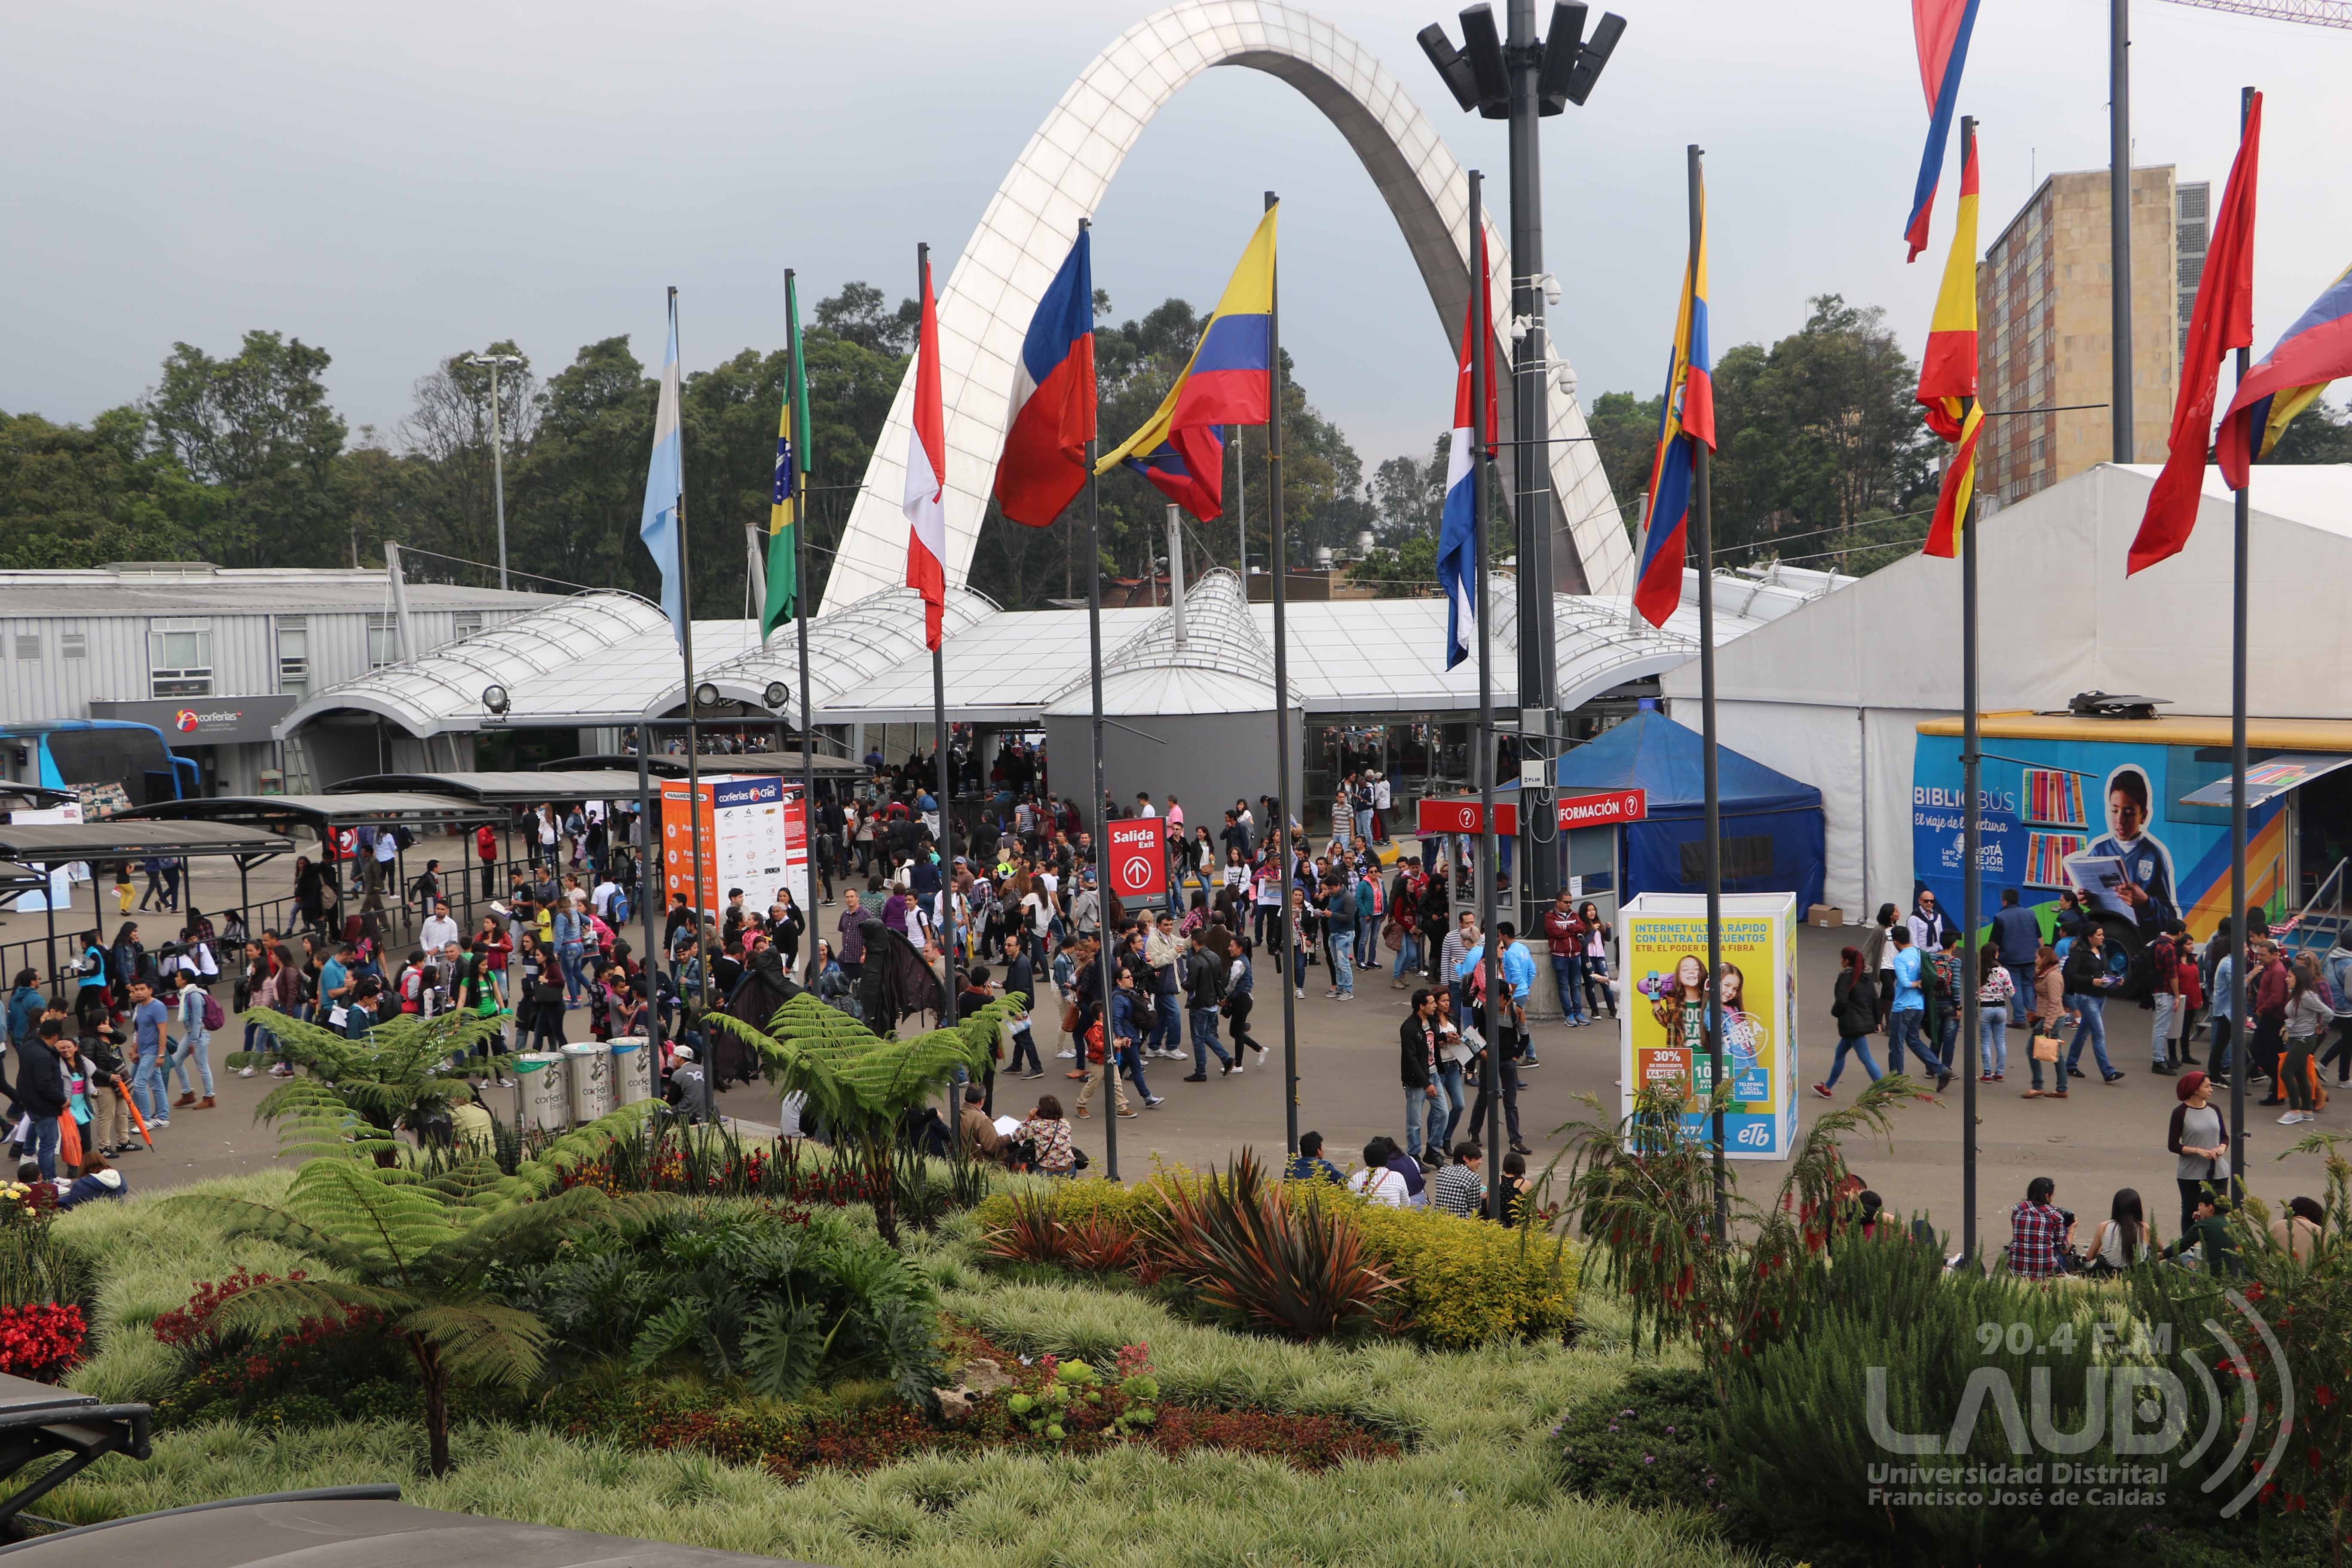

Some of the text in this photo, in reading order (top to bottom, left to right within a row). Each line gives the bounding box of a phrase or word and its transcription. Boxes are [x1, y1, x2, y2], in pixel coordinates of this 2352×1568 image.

[199, 711, 237, 722] corferias
[719, 791, 749, 802] corferias
[1914, 786, 2015, 811] BIBLIBÚS
[1559, 799, 1619, 821] FORMACIÓN
[683, 824, 704, 832] Pabn
[1915, 813, 1925, 826] El
[1926, 815, 1947, 832] viaje
[1947, 815, 1959, 829] de
[1975, 818, 2008, 833] ctura
[1113, 829, 1155, 844] Salida
[1138, 841, 1155, 849] Exit
[1976, 840, 2003, 856] GOTÁ
[1635, 922, 1767, 933] INTERNET ULTA RÁPIDO
[1635, 934, 1766, 943] CON ULTRA DECUENTOS
[1723, 1021, 1764, 1049] FIBRA
[1741, 1037, 1756, 1050] ETB
[1654, 1051, 1681, 1062] 30%
[628, 1077, 650, 1087] corfe
